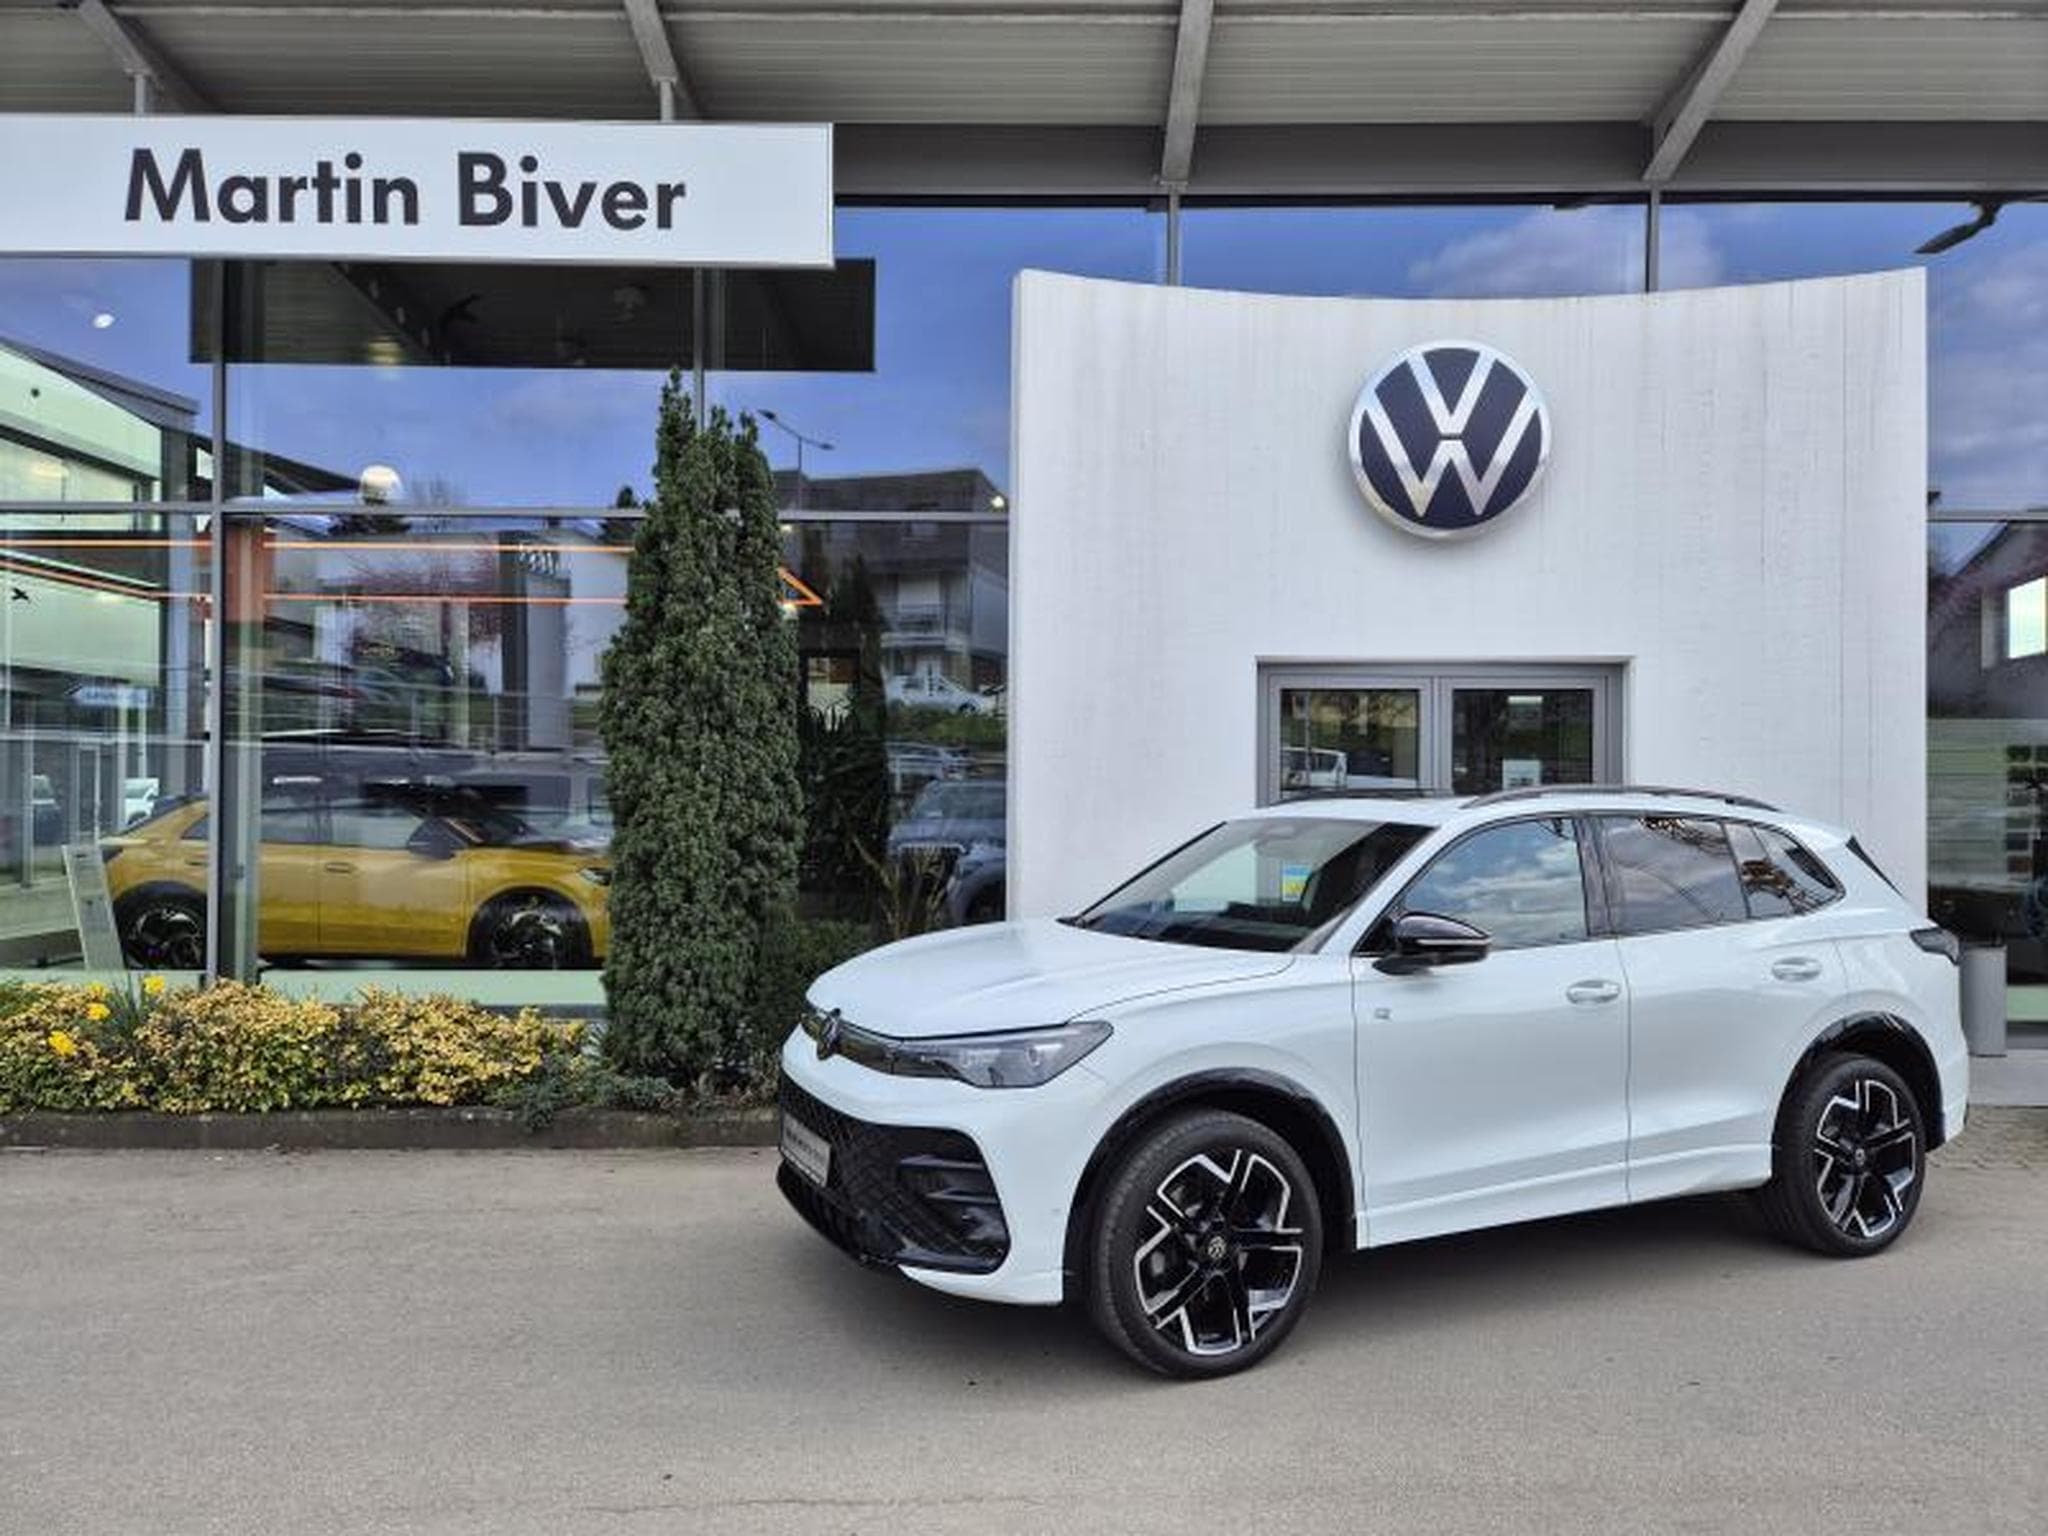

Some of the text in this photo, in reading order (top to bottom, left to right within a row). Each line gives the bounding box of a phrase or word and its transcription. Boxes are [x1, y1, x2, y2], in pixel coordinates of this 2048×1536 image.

[124, 148, 687, 231] Martin Biver
[1360, 346, 1543, 520] VW
